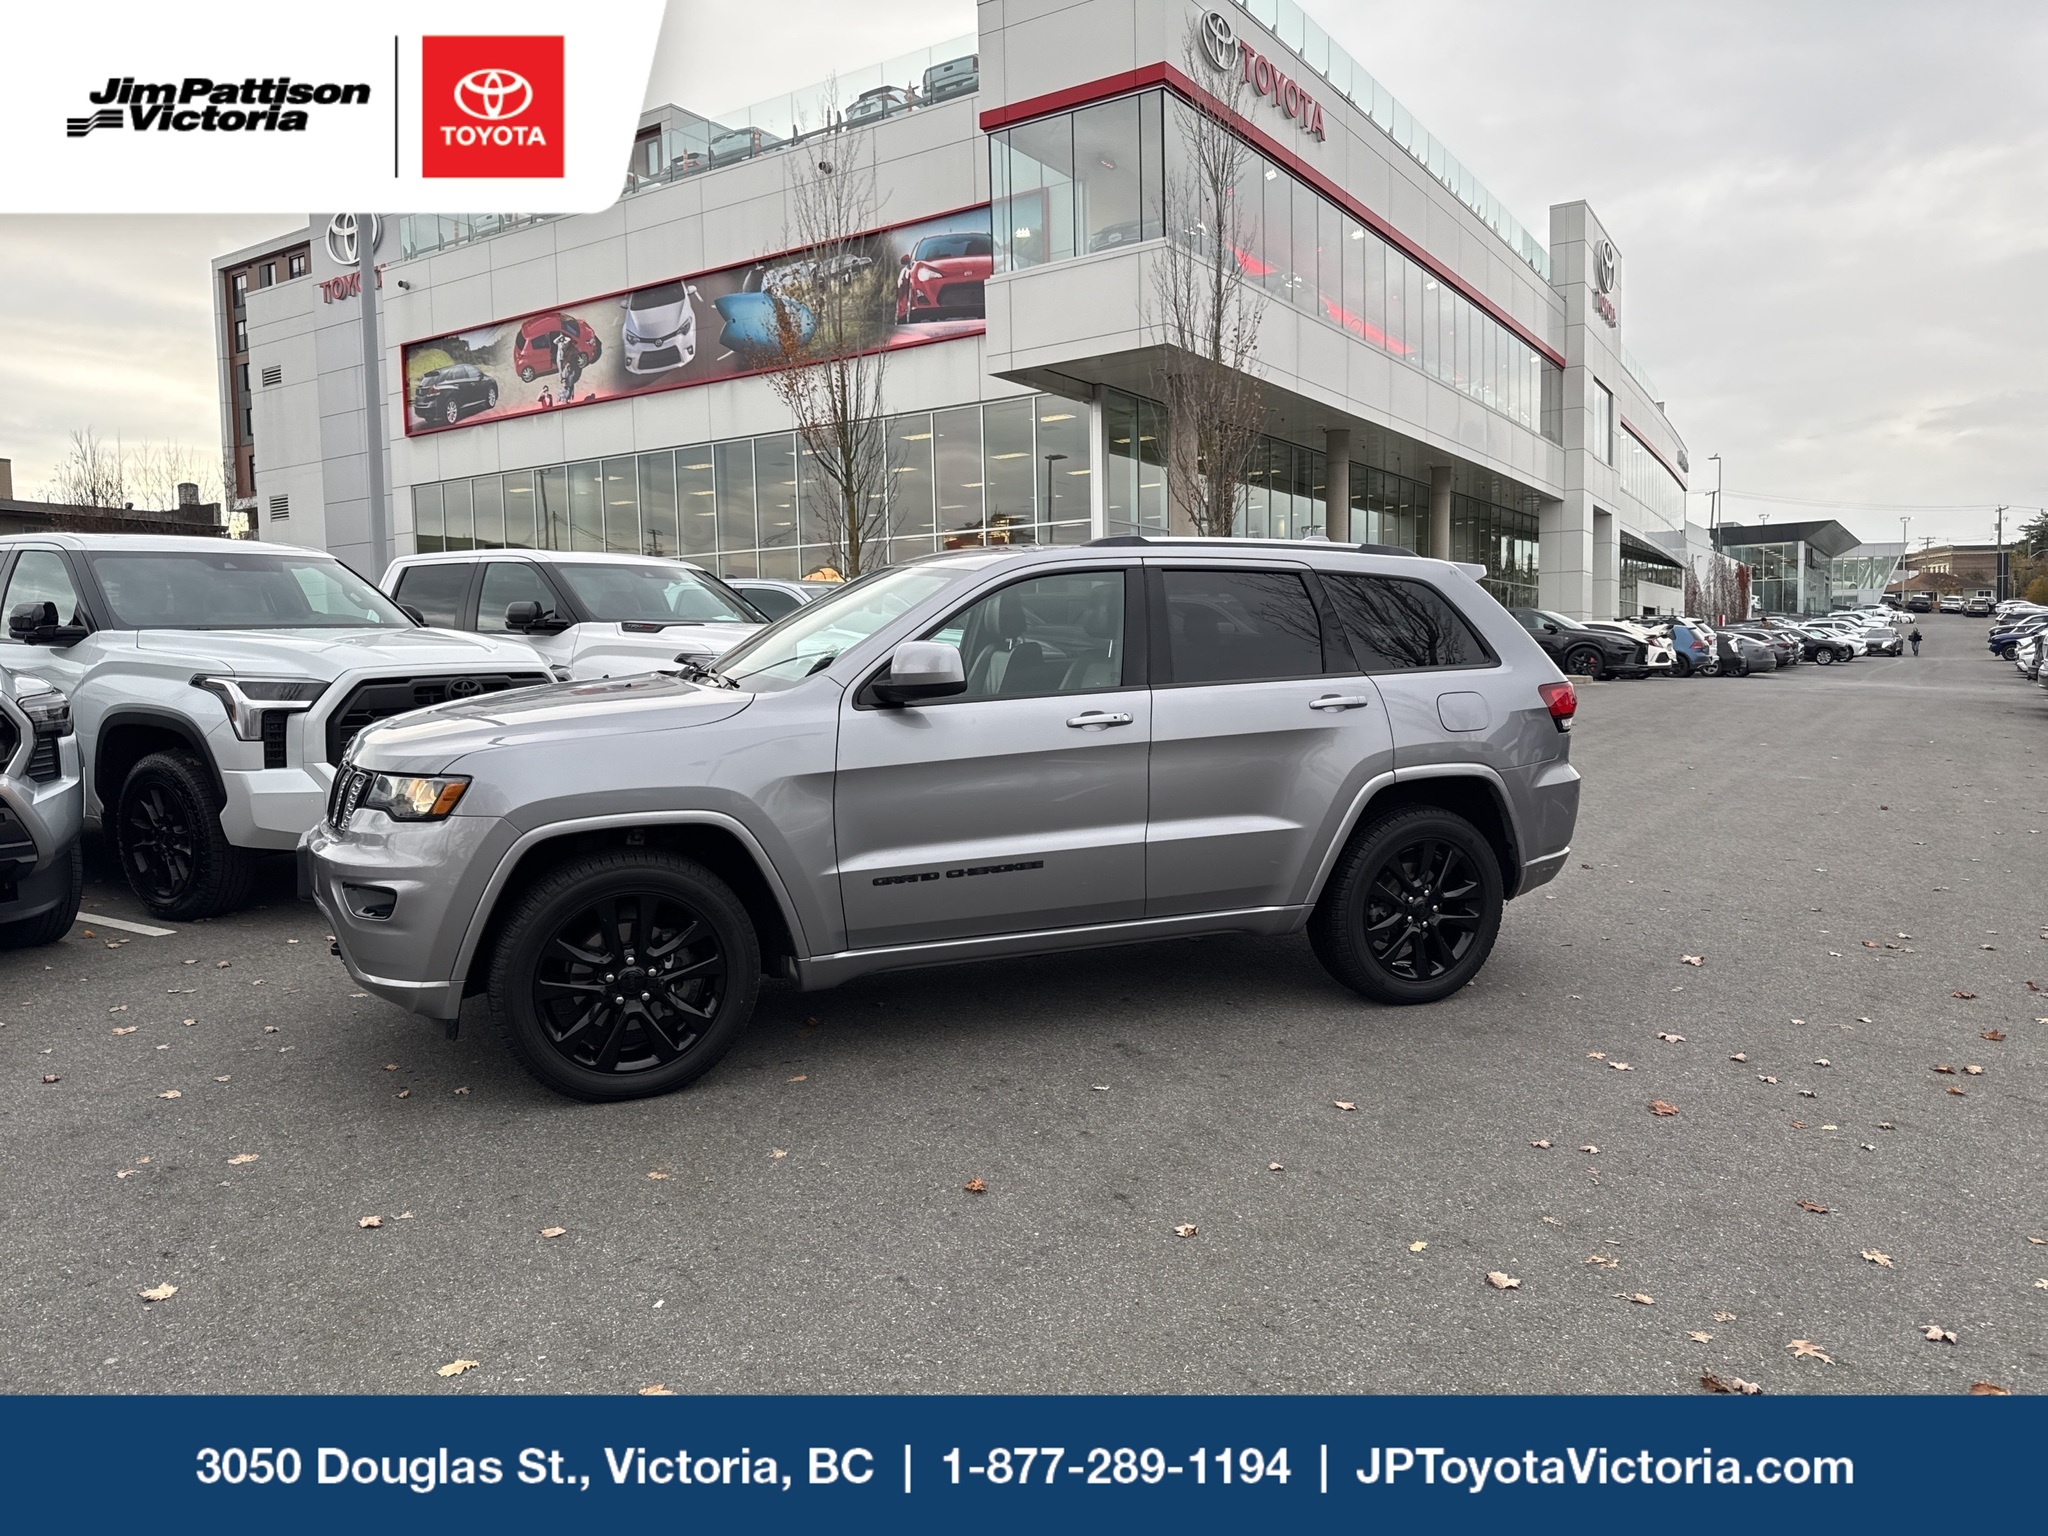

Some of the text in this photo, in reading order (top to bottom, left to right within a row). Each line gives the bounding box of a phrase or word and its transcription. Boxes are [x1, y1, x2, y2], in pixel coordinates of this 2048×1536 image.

[1239, 39, 1326, 142] TOYOTA
[319, 263, 387, 304] TOYT
[873, 860, 1044, 887] GRAND CHEROKEE
